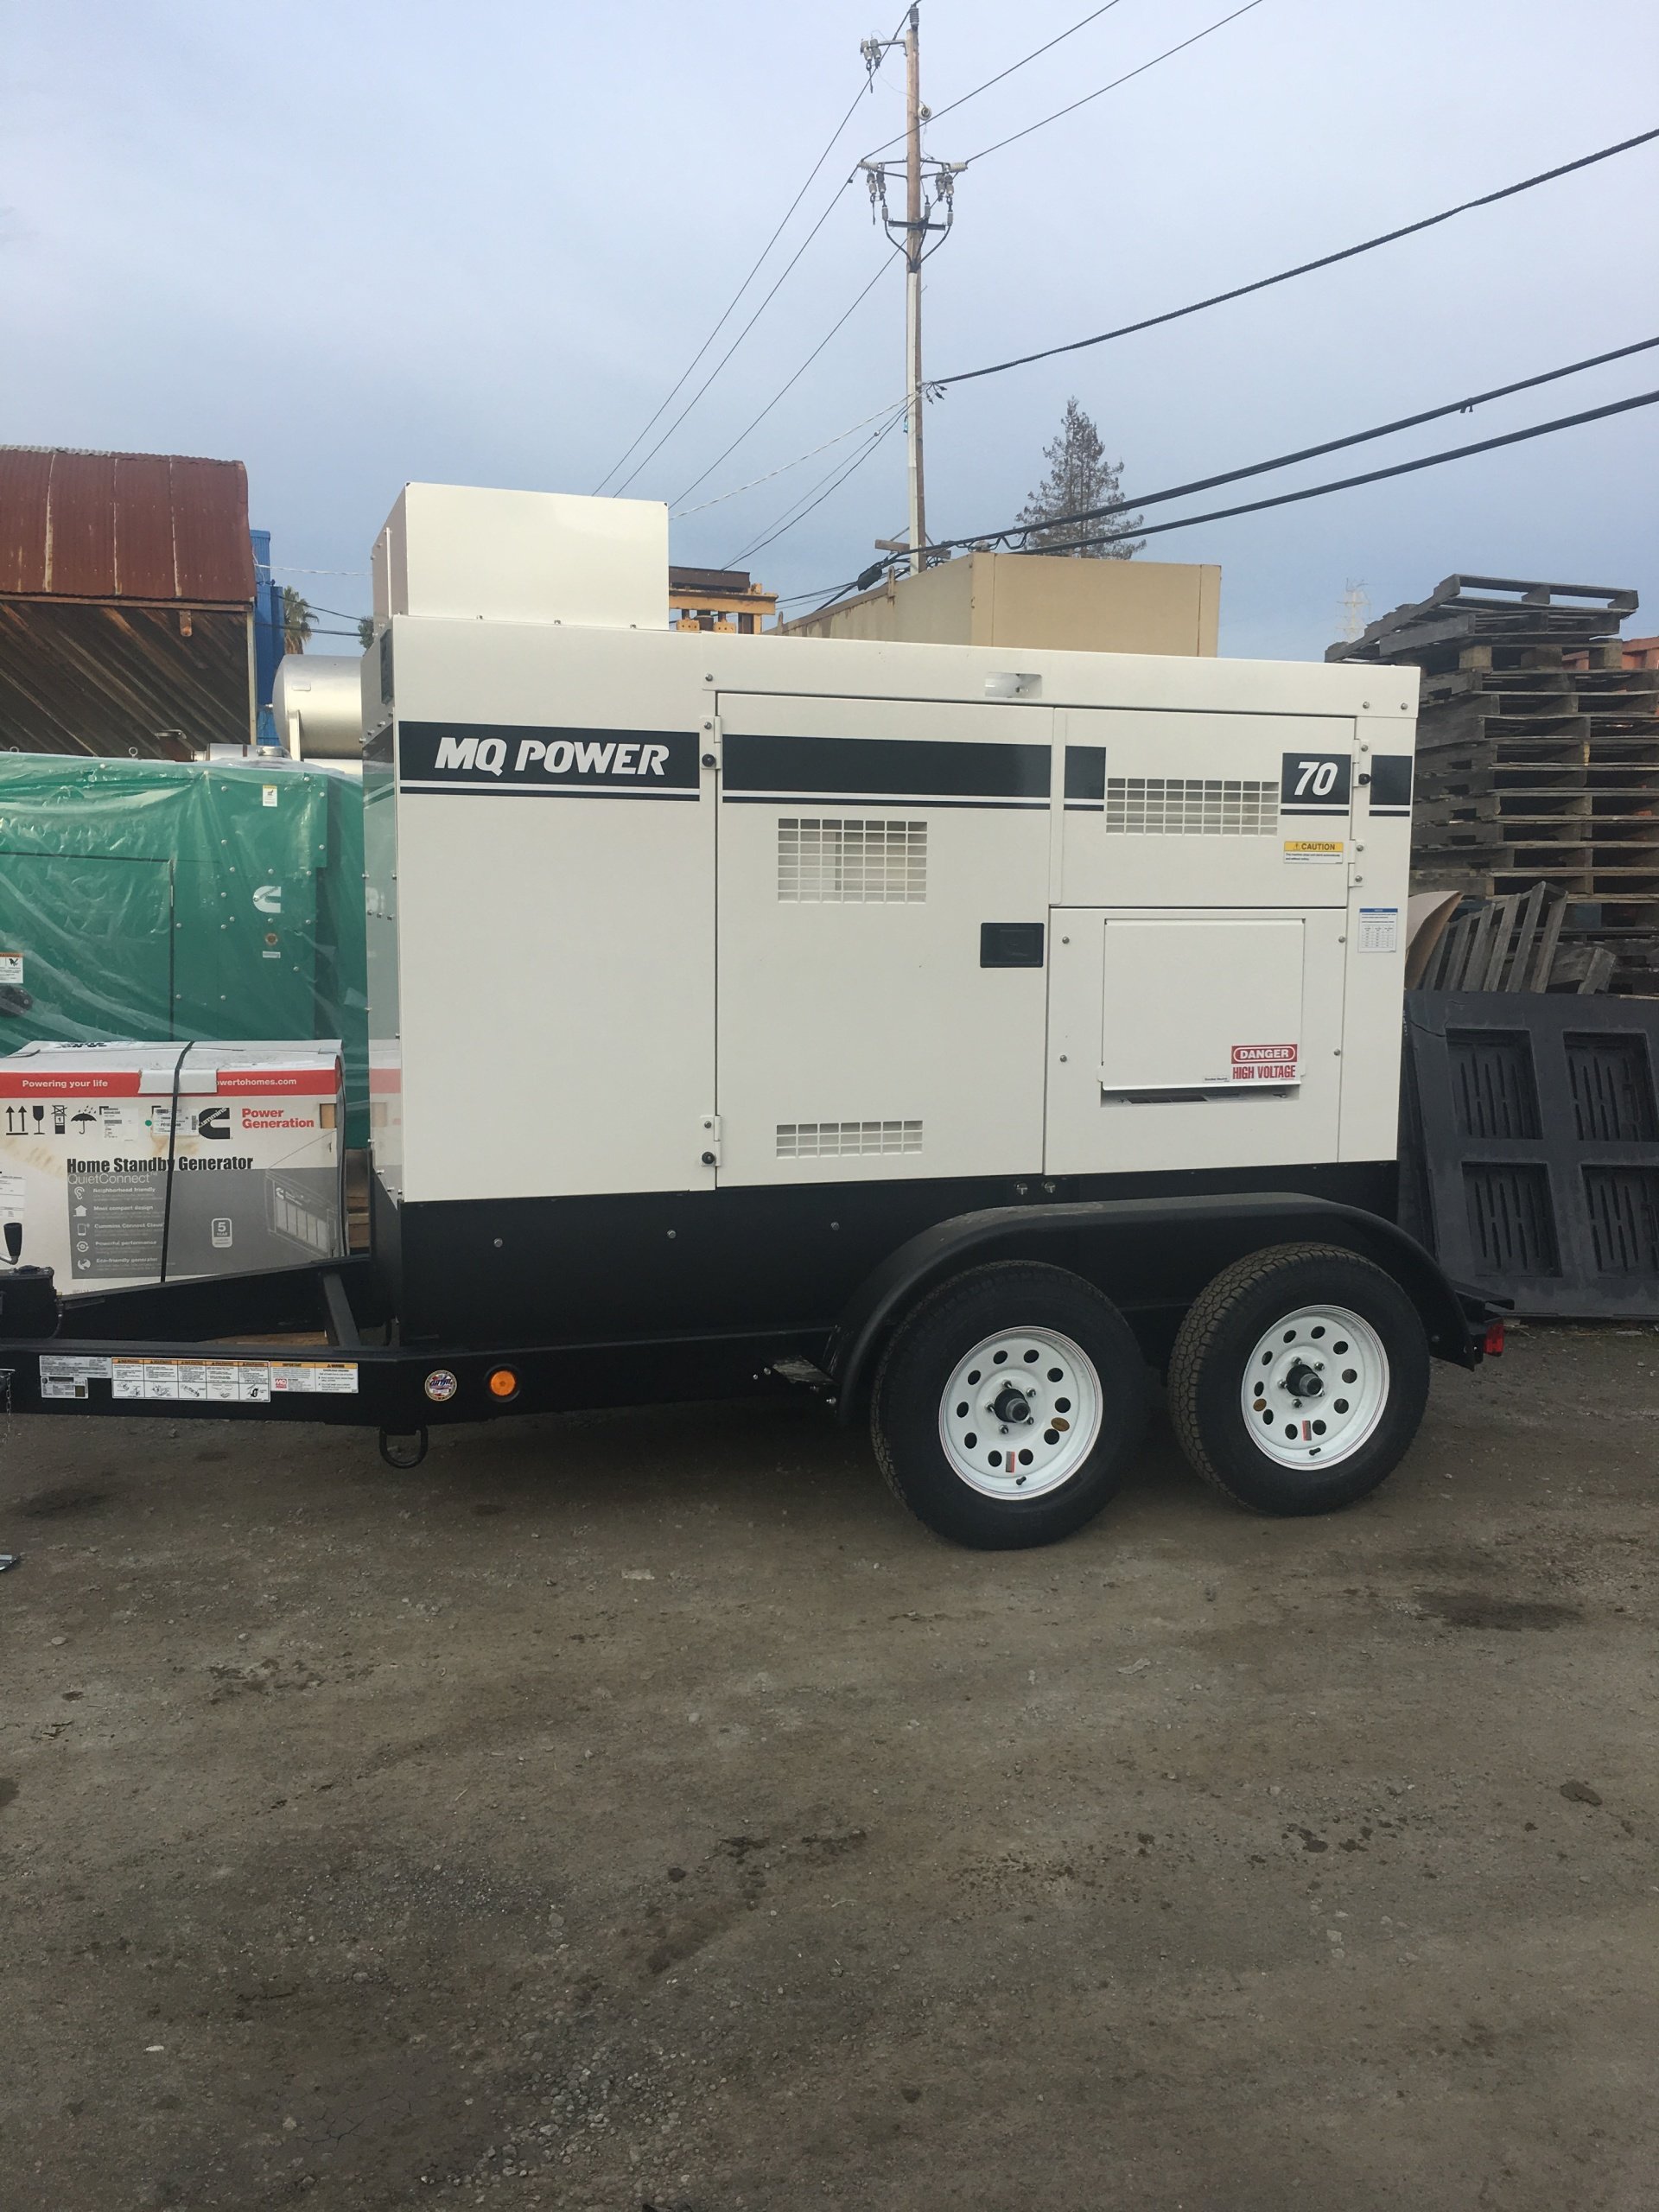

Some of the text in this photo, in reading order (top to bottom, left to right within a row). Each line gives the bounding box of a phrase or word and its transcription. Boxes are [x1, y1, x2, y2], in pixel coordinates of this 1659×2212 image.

[435, 737, 670, 776] MQ POWER
[1294, 761, 1338, 796] 70
[1240, 1049, 1289, 1059] DANGER
[1232, 1066, 1255, 1080] HIGH
[1257, 1065, 1296, 1079] VOLTAGE
[22, 1080, 67, 1089] Powering
[242, 1108, 284, 1118] Power
[242, 1118, 315, 1129] Generation
[67, 1159, 111, 1173] Home
[179, 1156, 254, 1171] Generator
[218, 1222, 226, 1232] 5
